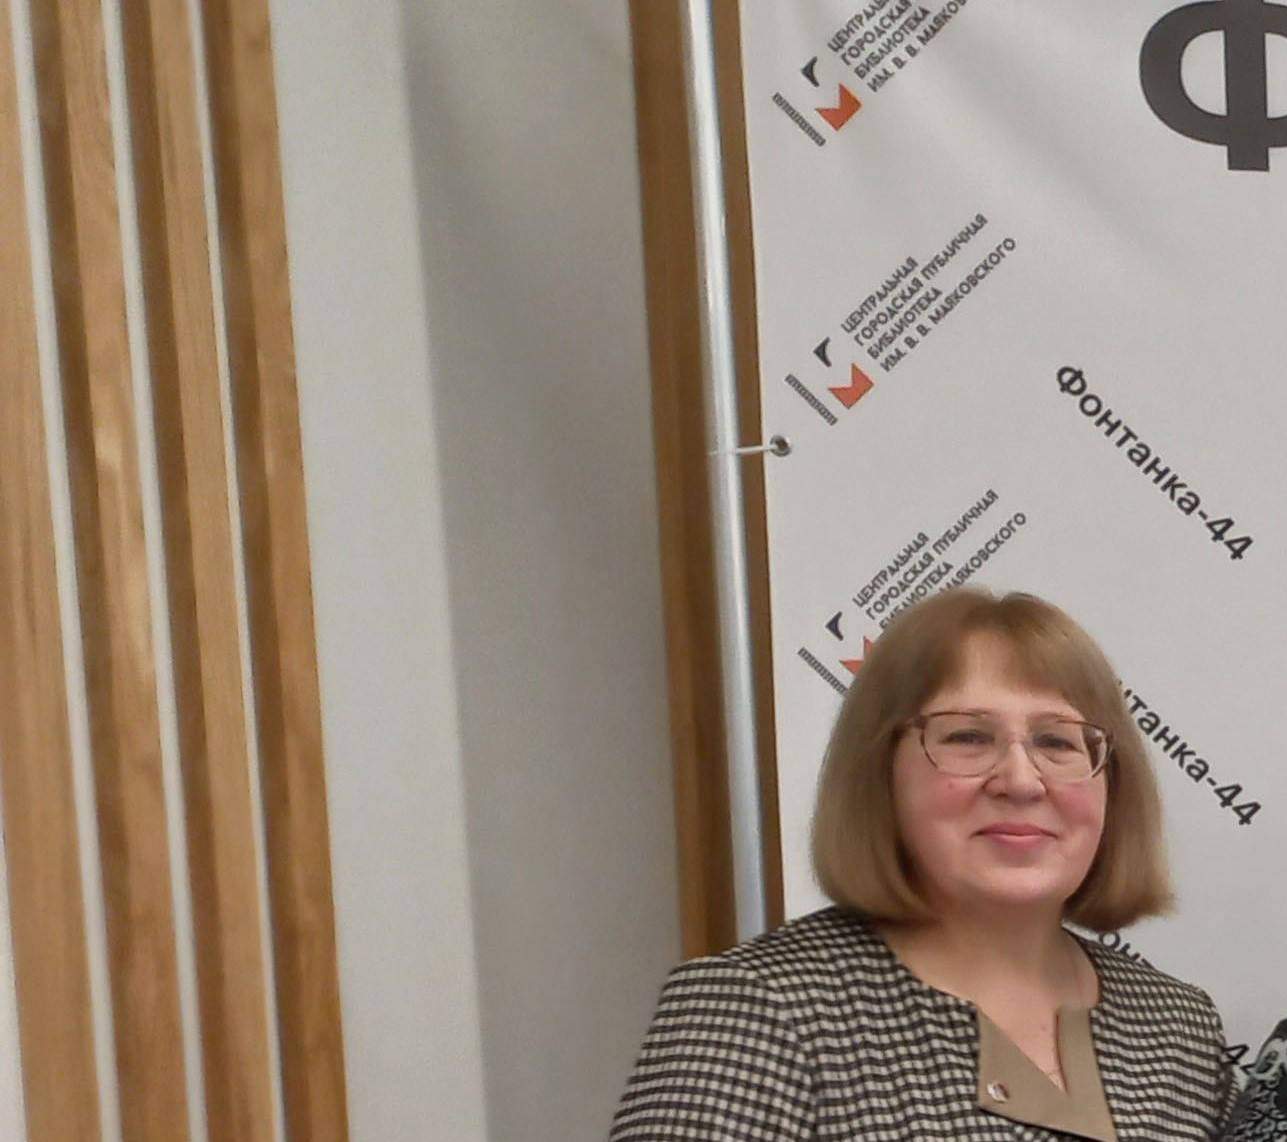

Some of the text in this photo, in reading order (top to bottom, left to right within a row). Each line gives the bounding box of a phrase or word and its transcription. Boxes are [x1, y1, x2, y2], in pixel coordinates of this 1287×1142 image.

[854, 6, 931, 80] БИБЛИОТЕКА
[841, 256, 918, 333] ЦЕНТРАЛЬНАЯ
[854, 214, 988, 346] ГОРОДСКАЯ ПУБЛИЧНАЯ
[867, 287, 942, 359] БИБЛИОТЕКА
[880, 348, 907, 372] ИМ.
[928, 238, 1016, 324] МАЯКОВСКОГО
[1057, 366, 1254, 560] Фонтанка-44
[852, 532, 930, 608] ЦЕНТРАЛЬНАЯ
[866, 489, 999, 620] ГОРОДСКАЯ ПУБЛИЧНАЯ
